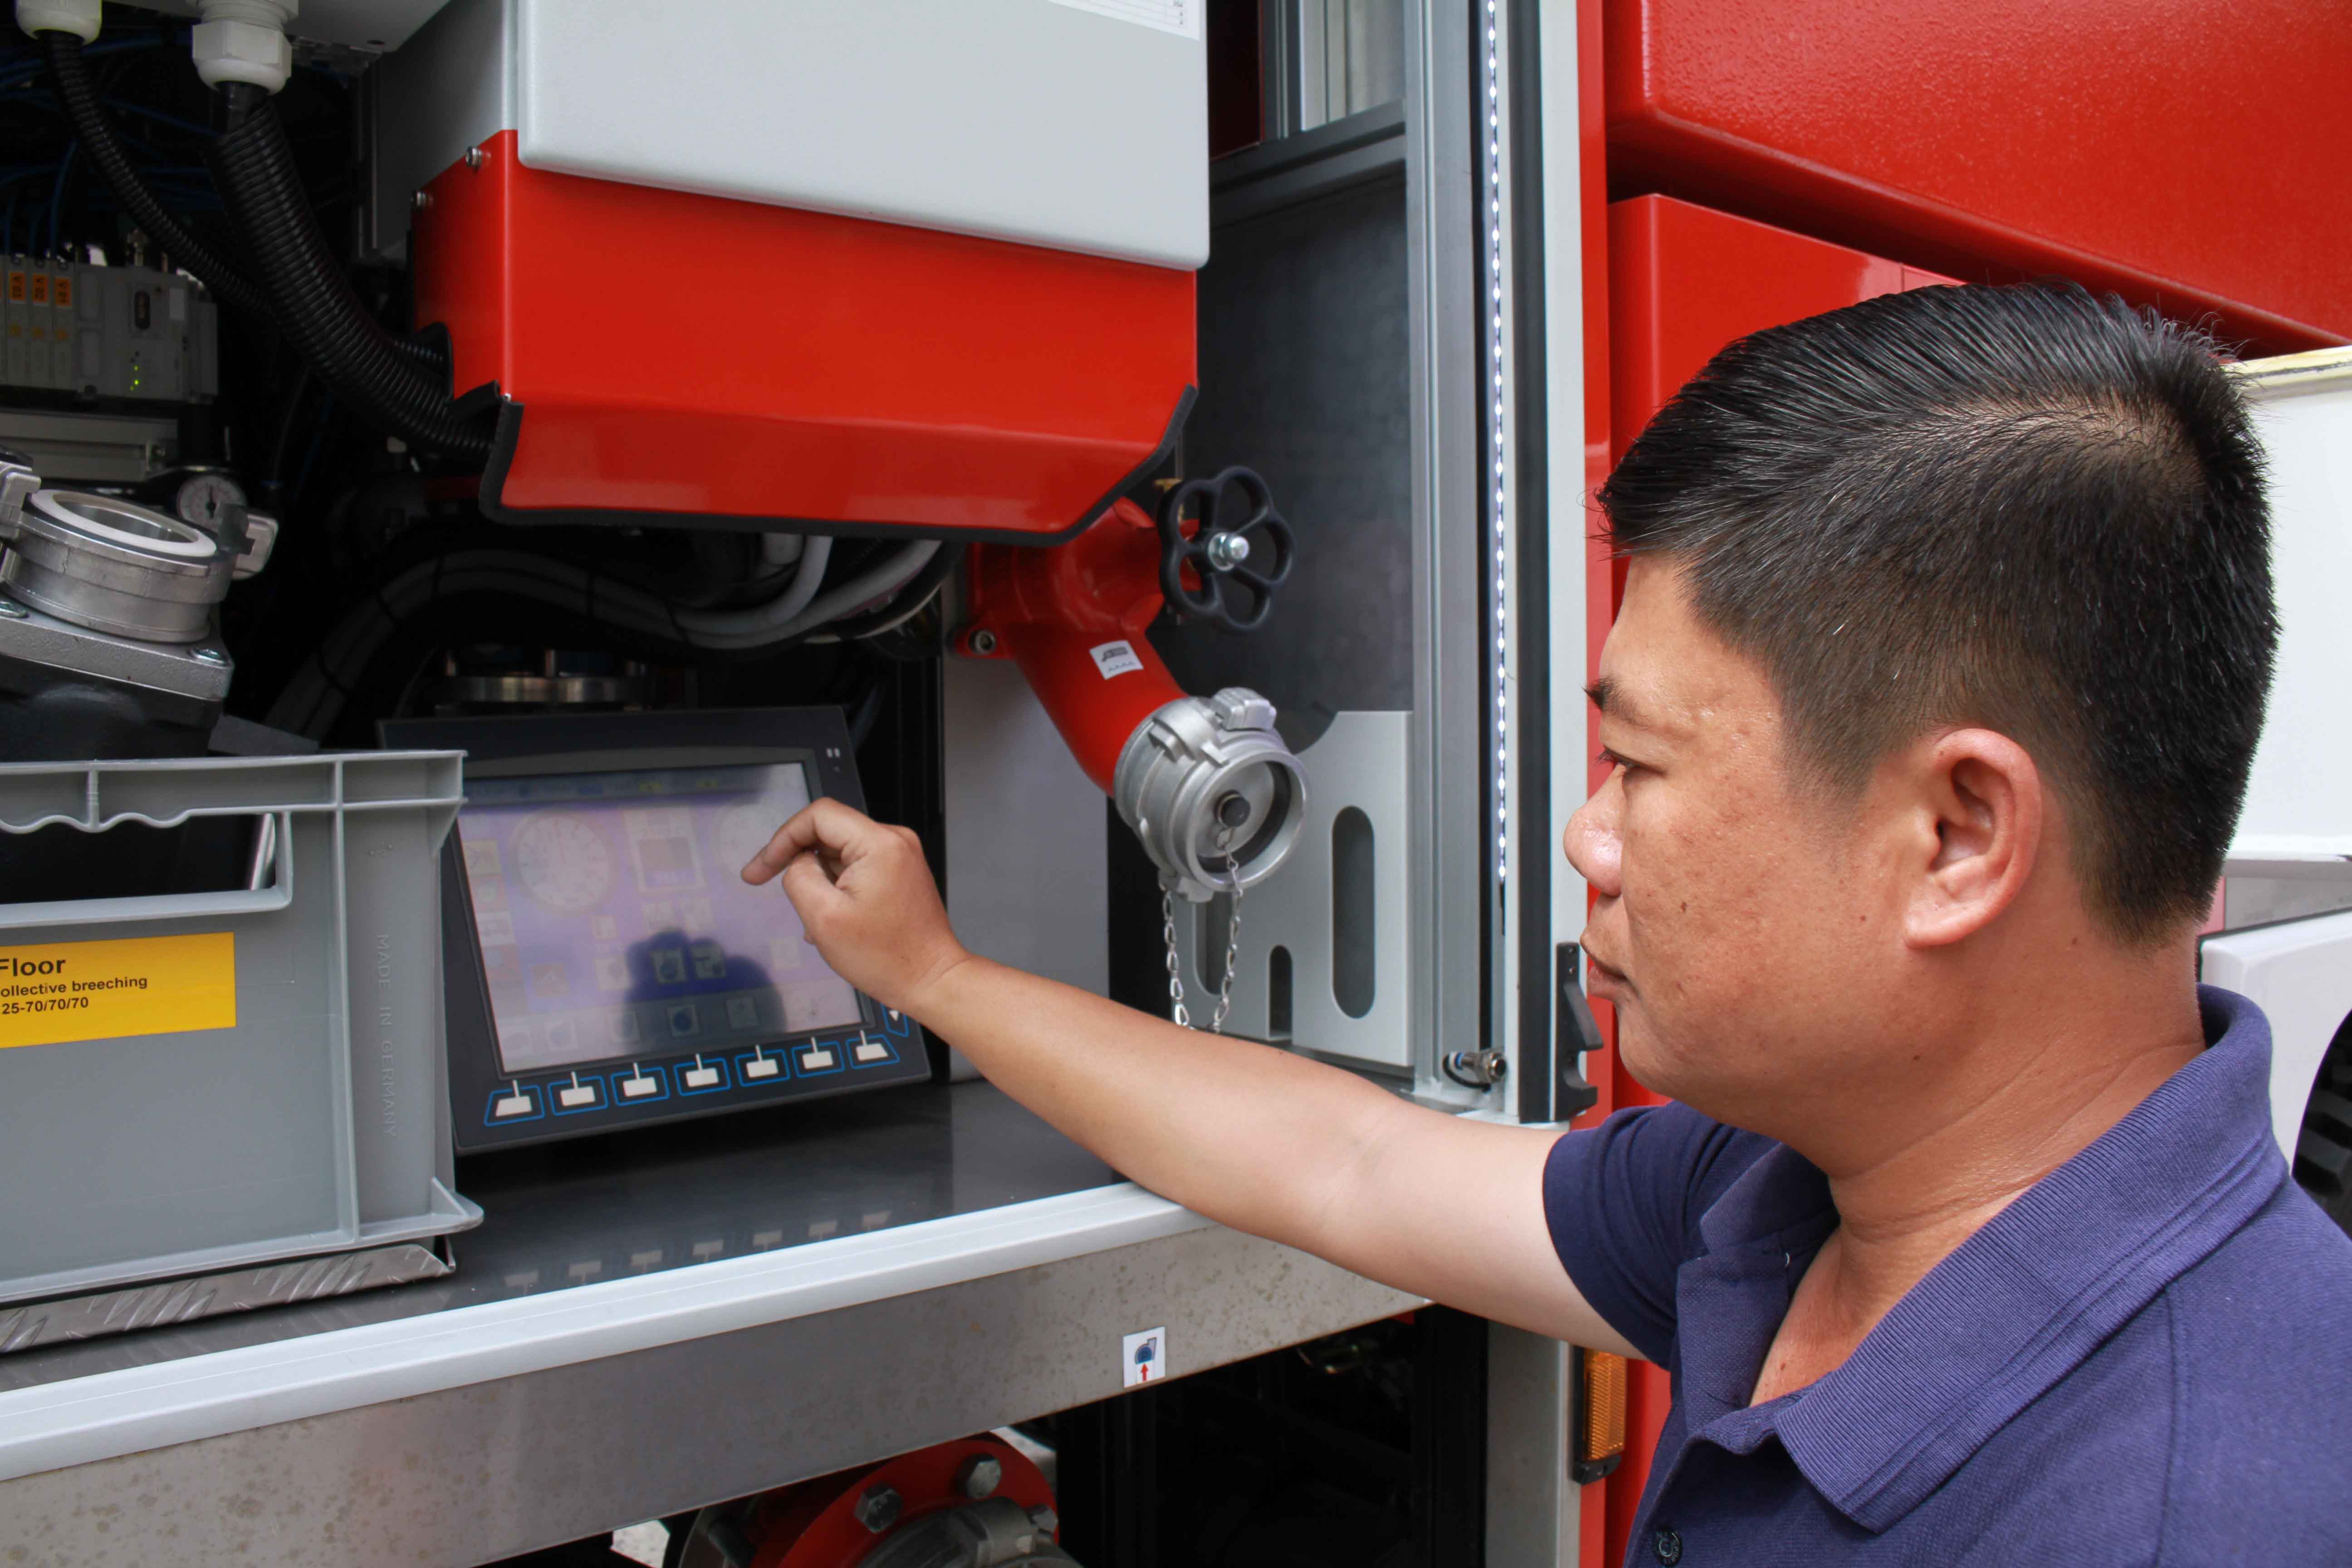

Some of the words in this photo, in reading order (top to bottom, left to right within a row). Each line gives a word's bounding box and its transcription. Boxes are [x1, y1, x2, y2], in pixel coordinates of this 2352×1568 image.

[377, 935, 391, 991] MADE
[1, 983, 66, 997] ollective
[72, 977, 147, 991] breeching
[2, 997, 88, 1014] 25-70/70/70
[379, 1007, 392, 1026] IN
[381, 1040, 396, 1137] GERMANY
